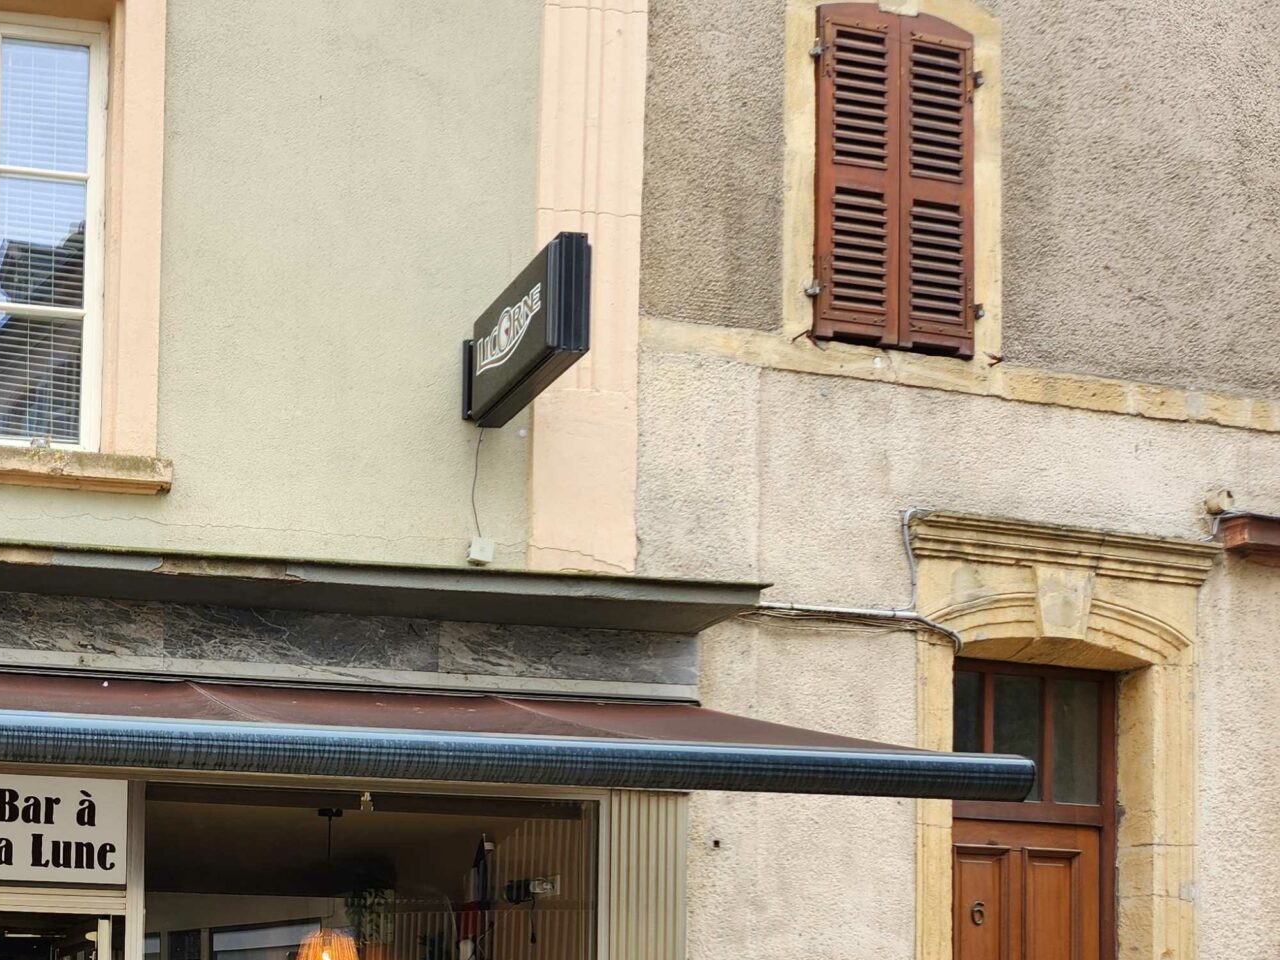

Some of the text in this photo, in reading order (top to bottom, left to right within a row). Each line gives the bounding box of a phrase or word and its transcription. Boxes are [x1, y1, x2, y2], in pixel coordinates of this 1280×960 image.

[476, 282, 541, 376] LICORNE
[76, 789, 96, 827] à
[31, 833, 117, 871] Lune
[971, 900, 985, 926] 6
